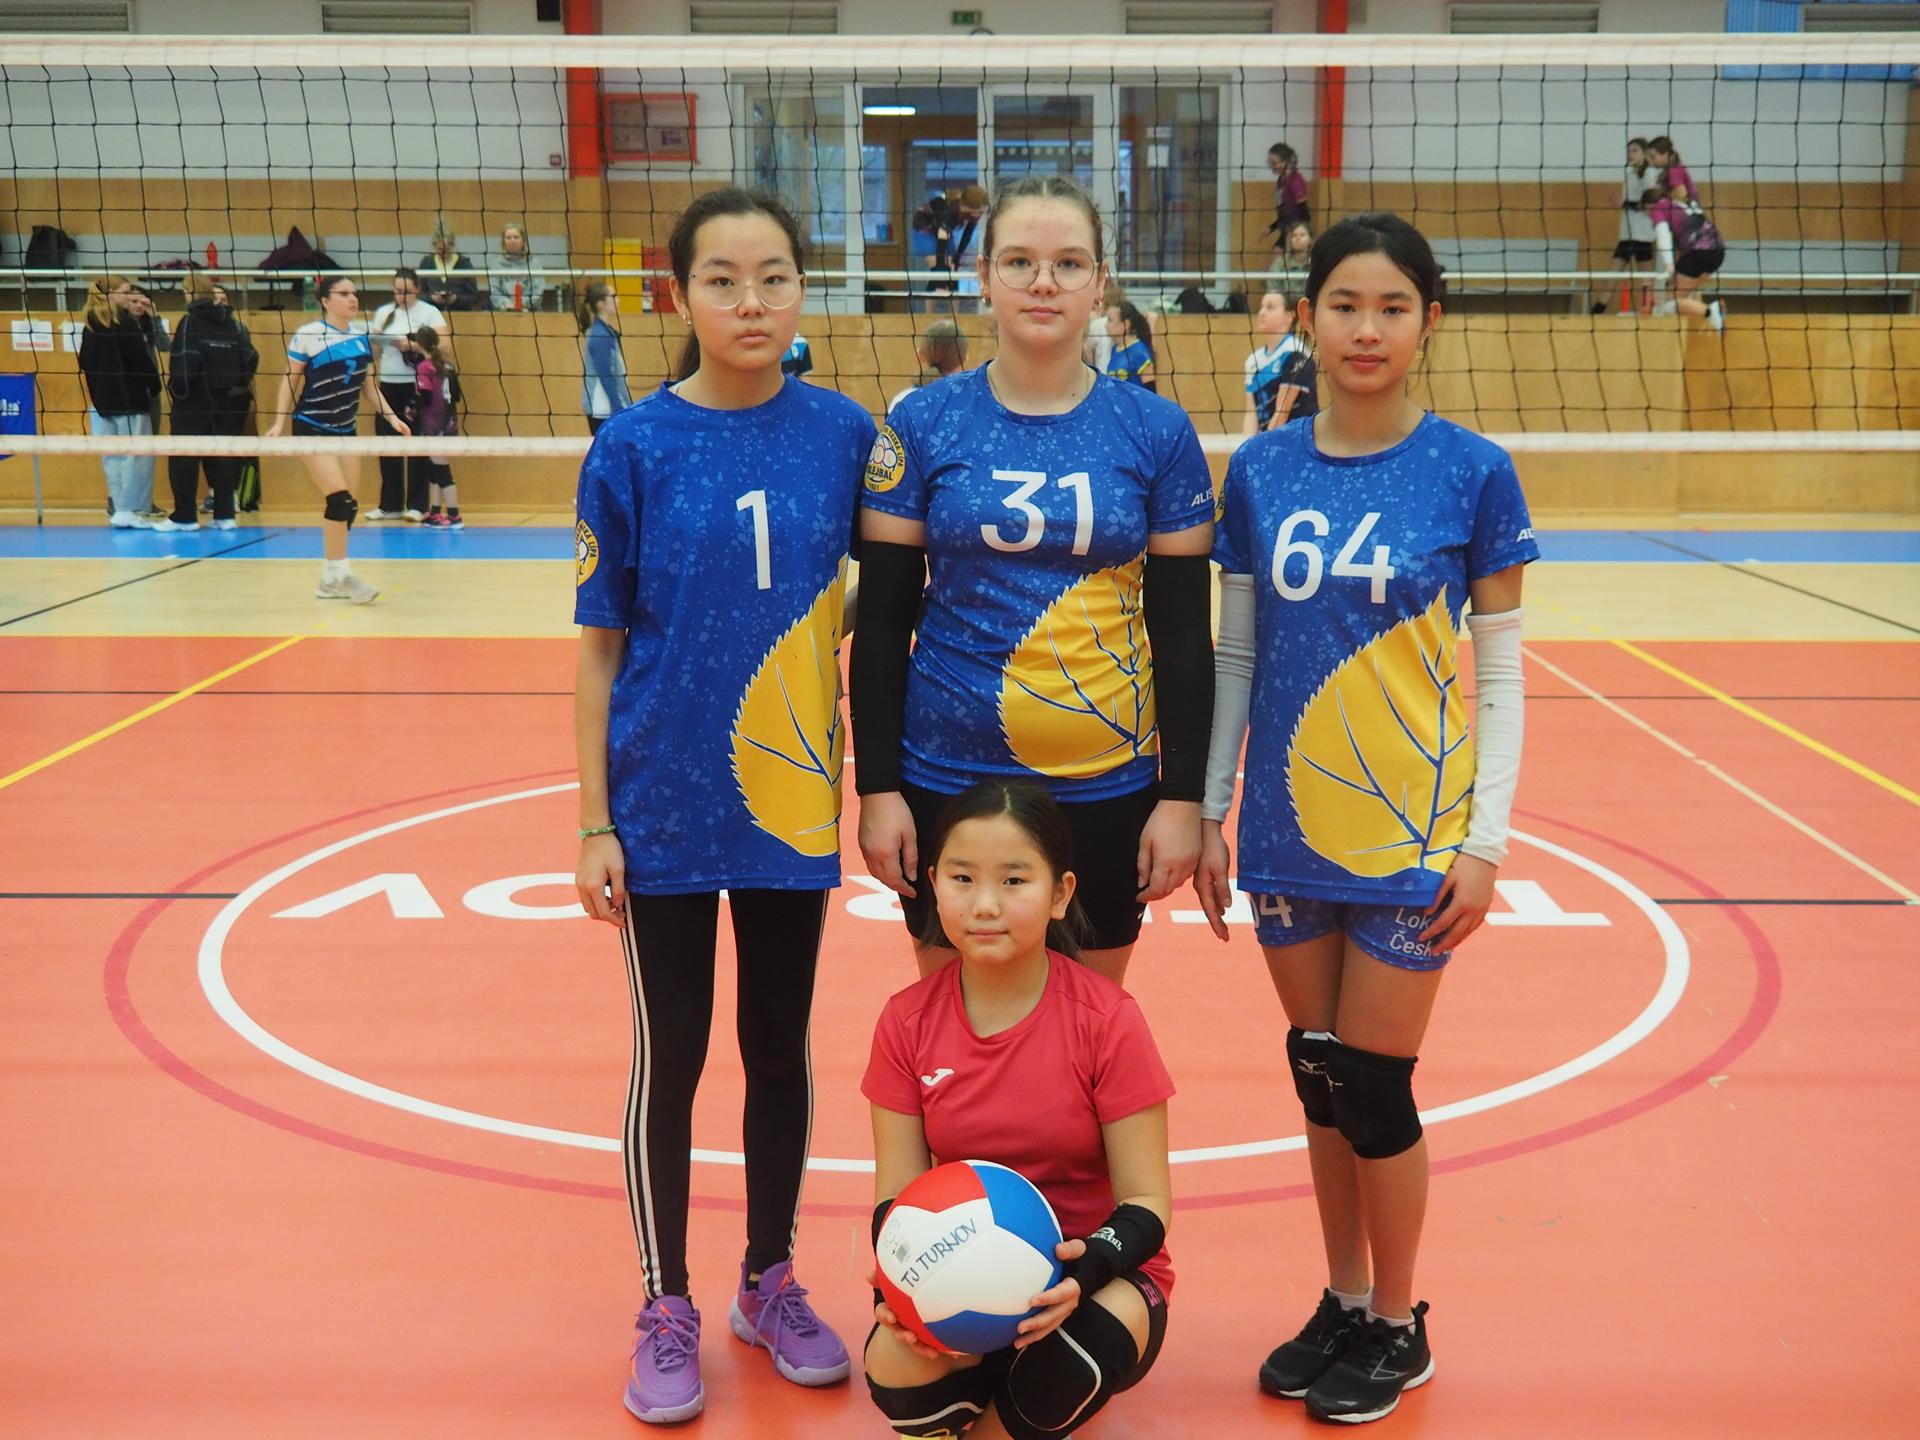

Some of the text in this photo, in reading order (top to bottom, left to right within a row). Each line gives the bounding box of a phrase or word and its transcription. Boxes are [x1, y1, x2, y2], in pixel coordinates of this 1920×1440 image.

[736, 490, 771, 590] 1
[981, 470, 1093, 556] 31
[1272, 509, 1395, 604] 64
[1389, 928, 1434, 957] Česk
[1395, 907, 1432, 930] Lok
[900, 1217, 978, 1288] TJ TURNOV
